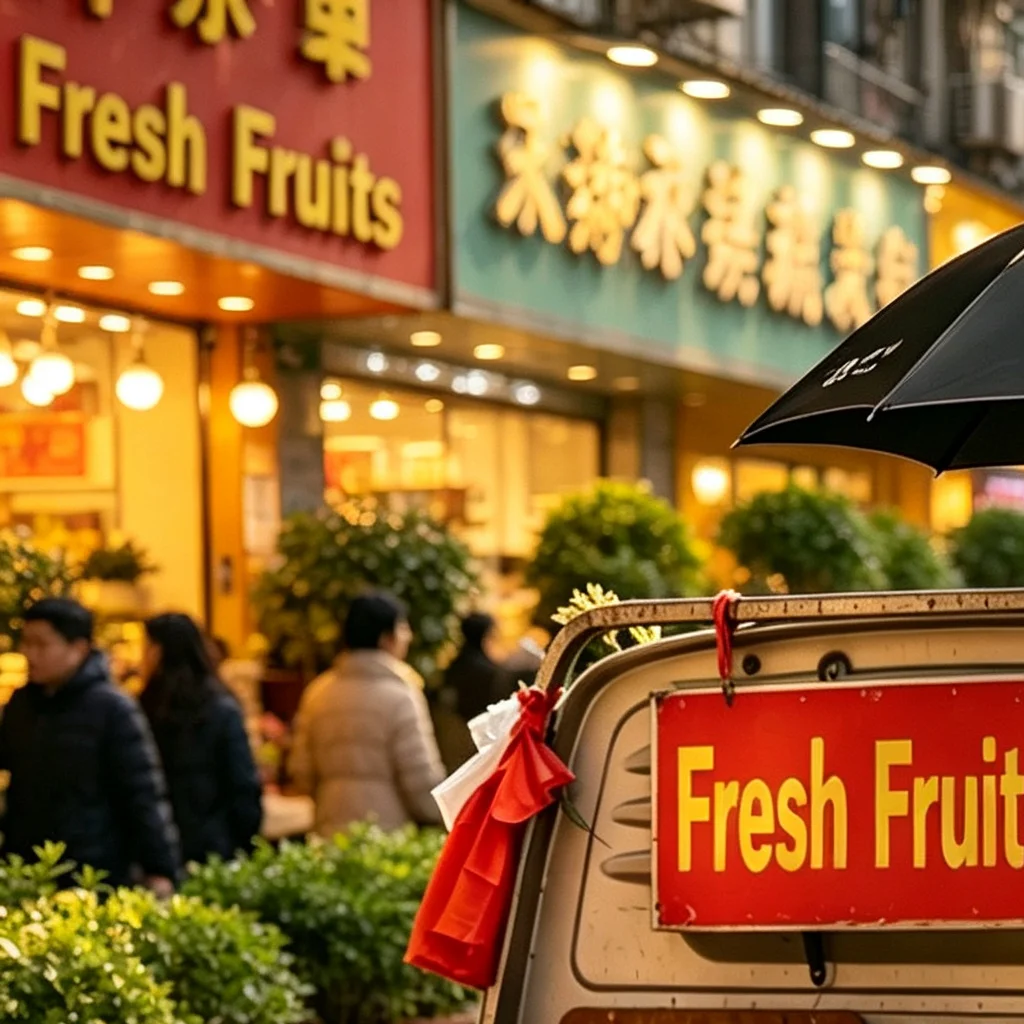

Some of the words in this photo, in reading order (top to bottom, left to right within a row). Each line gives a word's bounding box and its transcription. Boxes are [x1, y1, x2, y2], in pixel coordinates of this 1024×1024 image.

[19, 33, 206, 195] Fresh
[232, 104, 403, 250] Fruits
[677, 736, 848, 873] Fresh
